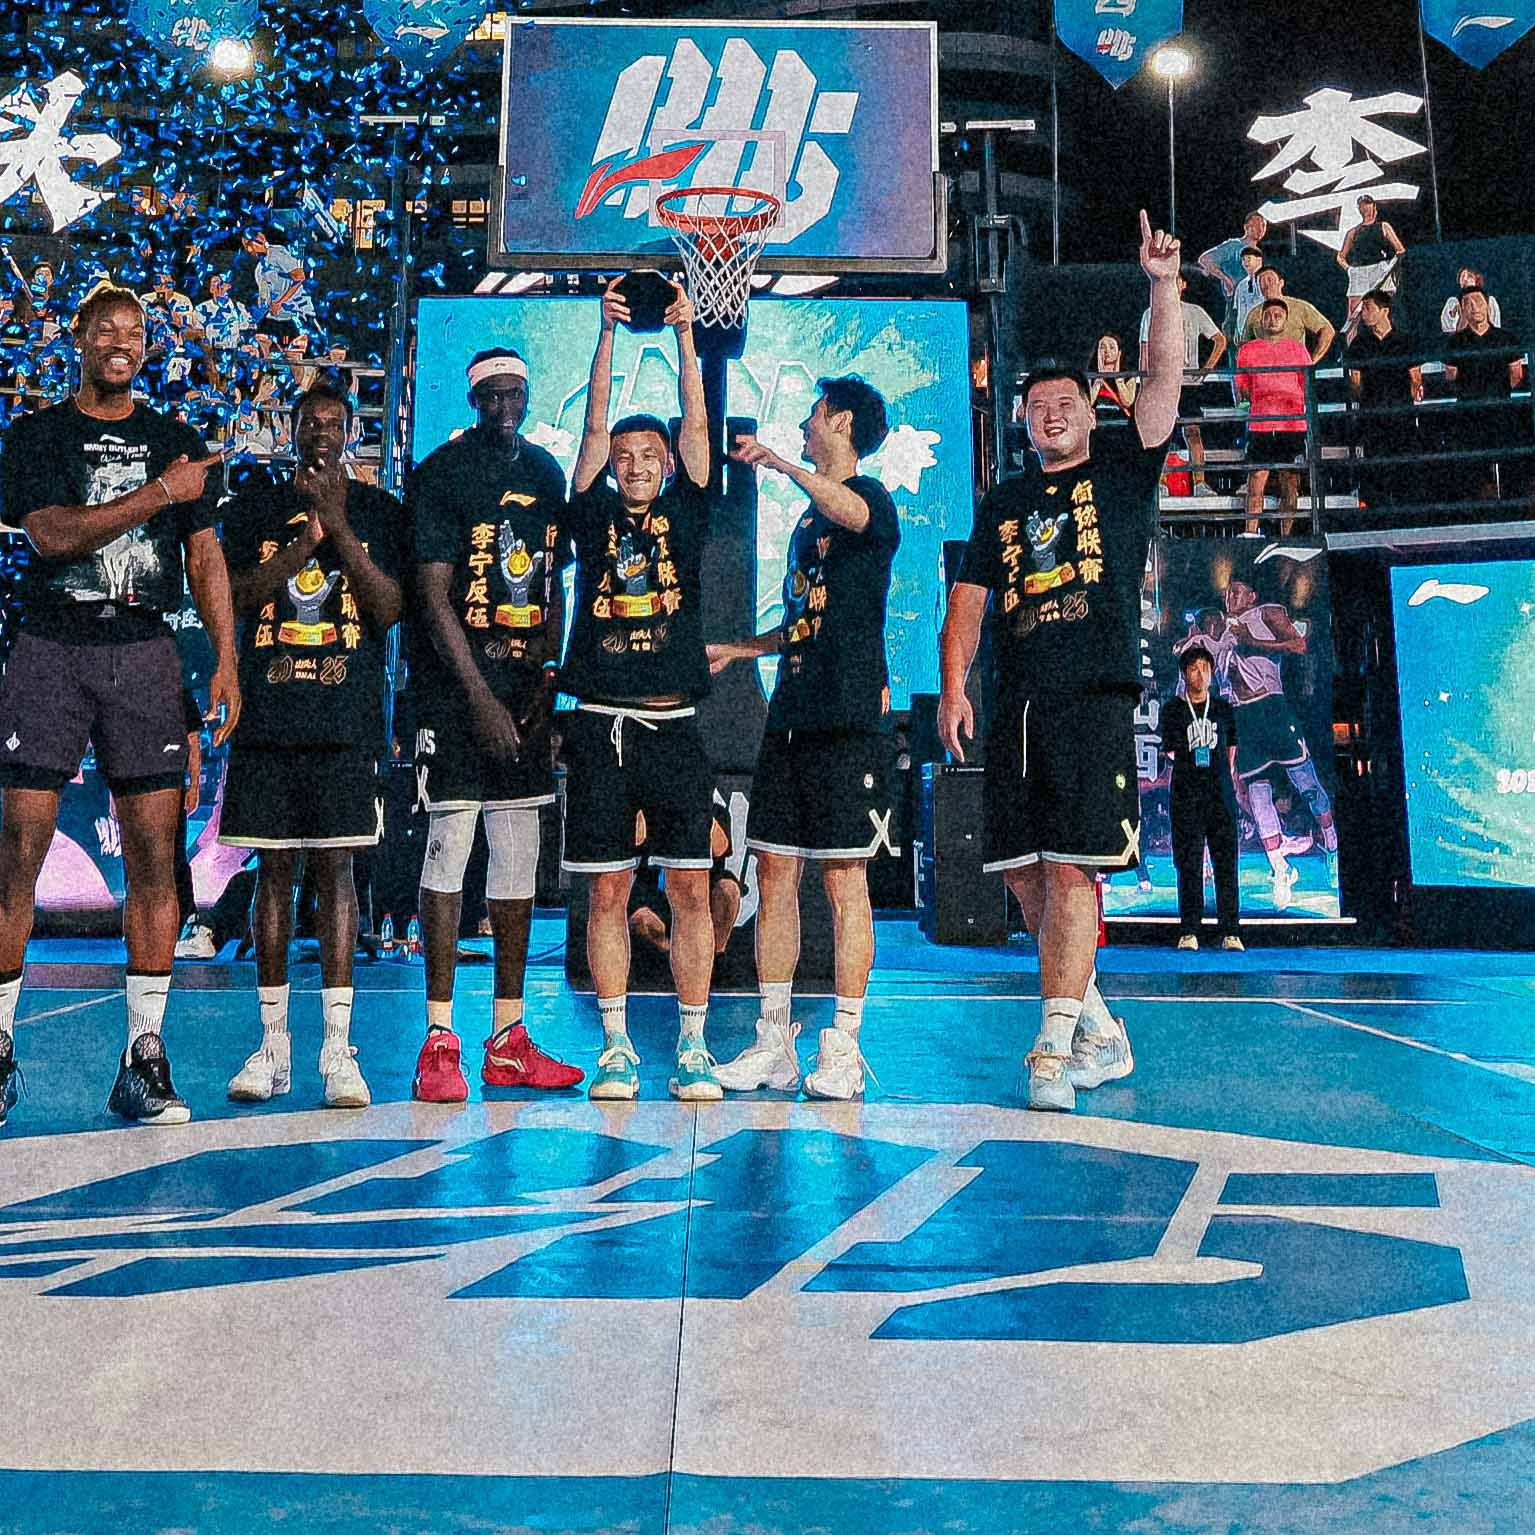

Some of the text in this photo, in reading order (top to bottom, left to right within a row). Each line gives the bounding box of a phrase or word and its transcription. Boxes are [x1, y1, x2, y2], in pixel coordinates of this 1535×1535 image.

[1247, 87, 1428, 251] 李
[465, 523, 495, 629] 李宁反伍
